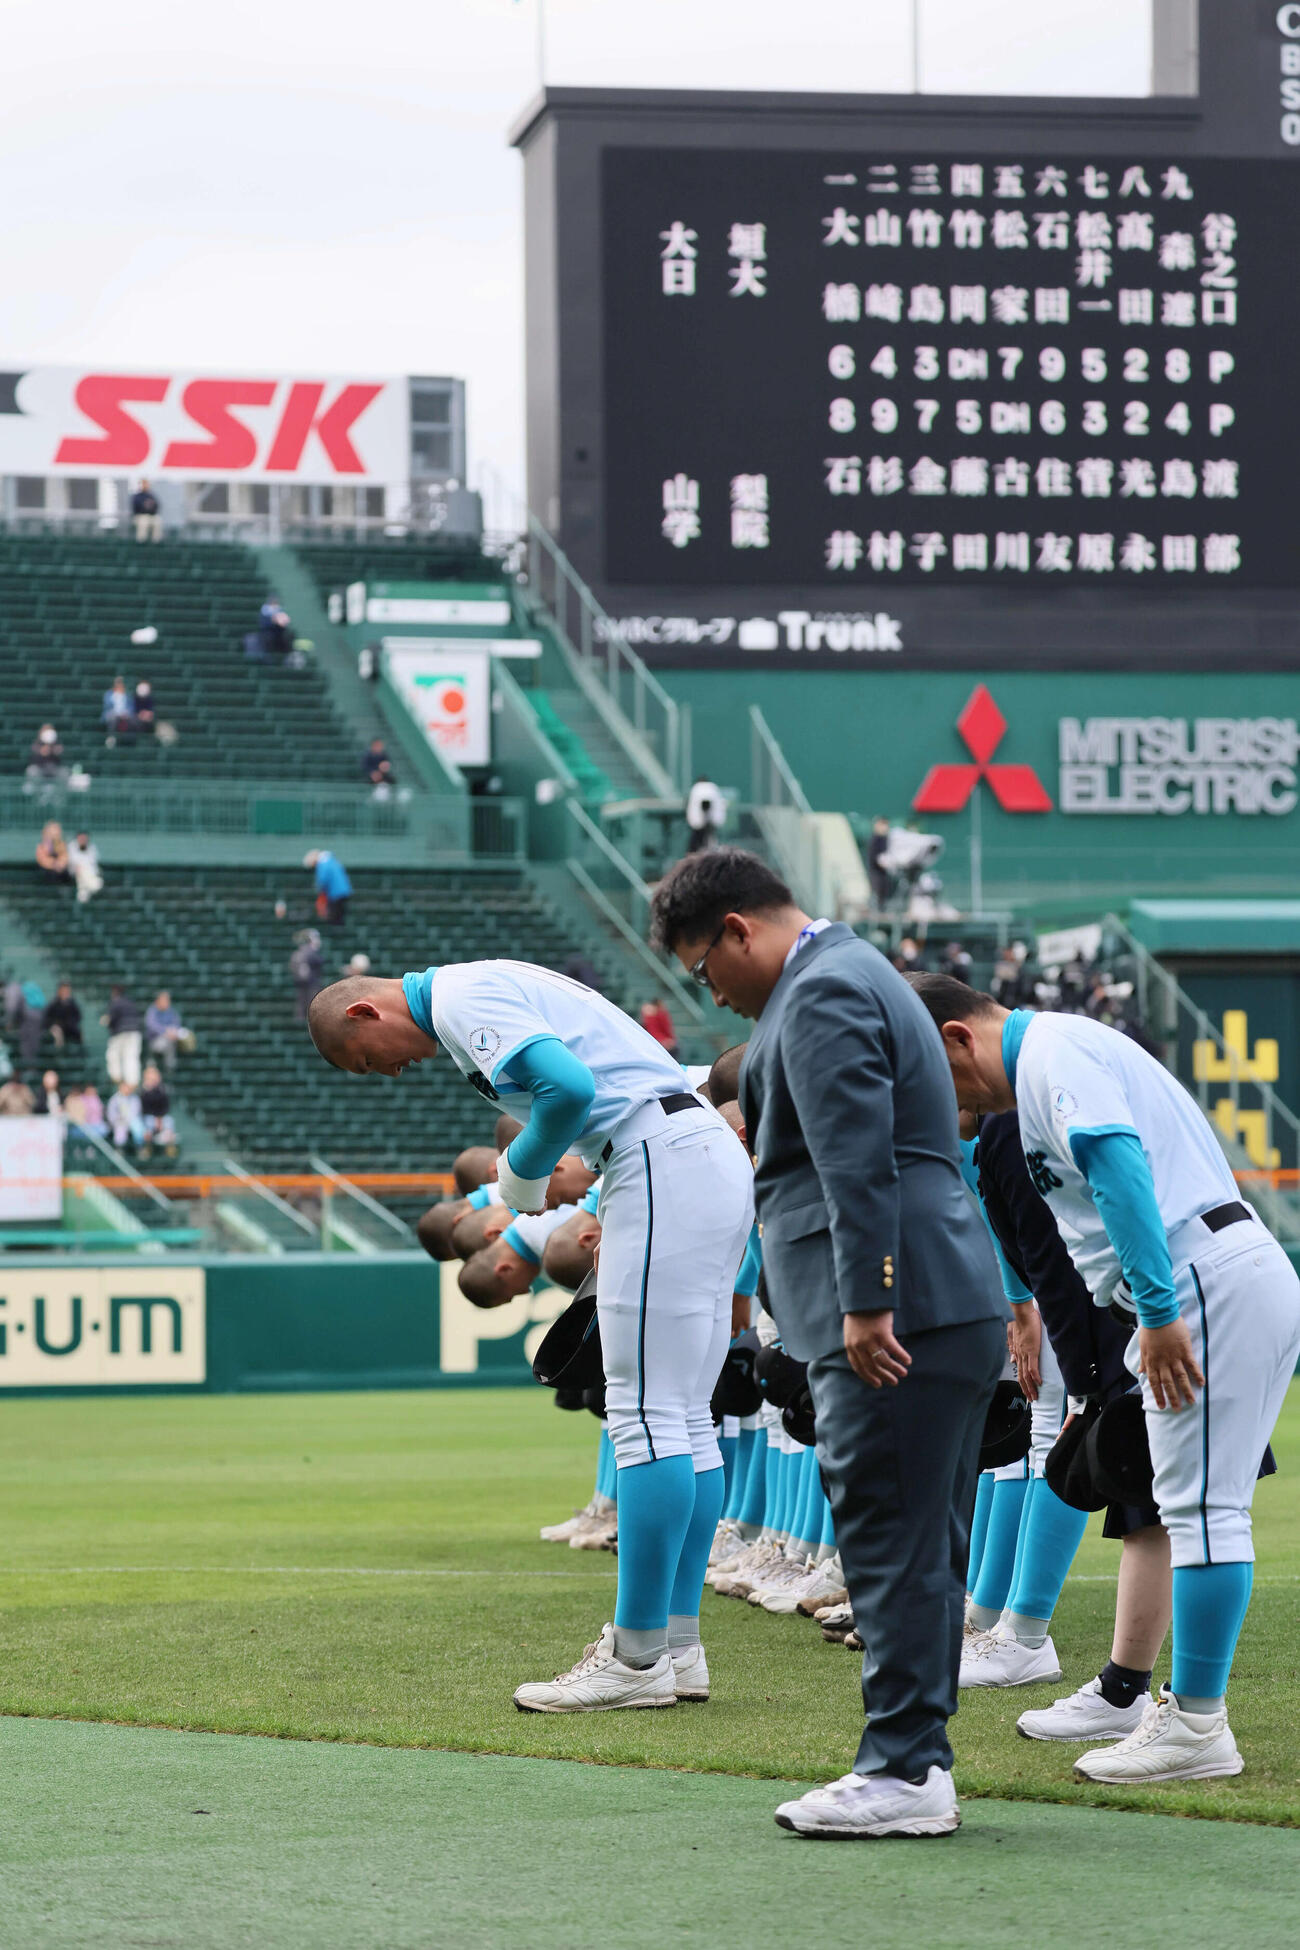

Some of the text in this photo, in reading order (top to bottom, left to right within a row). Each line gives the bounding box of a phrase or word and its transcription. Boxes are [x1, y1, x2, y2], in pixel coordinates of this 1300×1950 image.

[869, 165, 899, 192] 二
[911, 164, 941, 194] 三
[951, 164, 983, 196] 四
[995, 165, 1025, 197] 五
[1036, 166, 1067, 196] 六
[1080, 166, 1108, 198] 七
[1119, 166, 1151, 196] 八
[1162, 166, 1193, 200] 九
[829, 345, 855, 379] 6
[871, 346, 897, 378] 4
[914, 346, 939, 380] 3
[998, 347, 1023, 380] 7
[1039, 347, 1065, 381] 9
[1082, 348, 1107, 382] 5
[1123, 348, 1148, 382] 2
[1165, 348, 1190, 383] 8
[1209, 351, 1234, 383] P
[53, 373, 386, 474] SSK
[829, 398, 856, 432] 8
[871, 398, 898, 433] 9
[914, 399, 939, 432] 7
[956, 400, 982, 434] 5
[1040, 400, 1066, 434] 6
[1082, 401, 1107, 435] 3
[1124, 401, 1149, 435] 2
[1165, 402, 1190, 435] 4
[1210, 404, 1234, 436] P
[777, 611, 902, 651] Trunk
[1059, 765, 1297, 815] ELECTRIC
